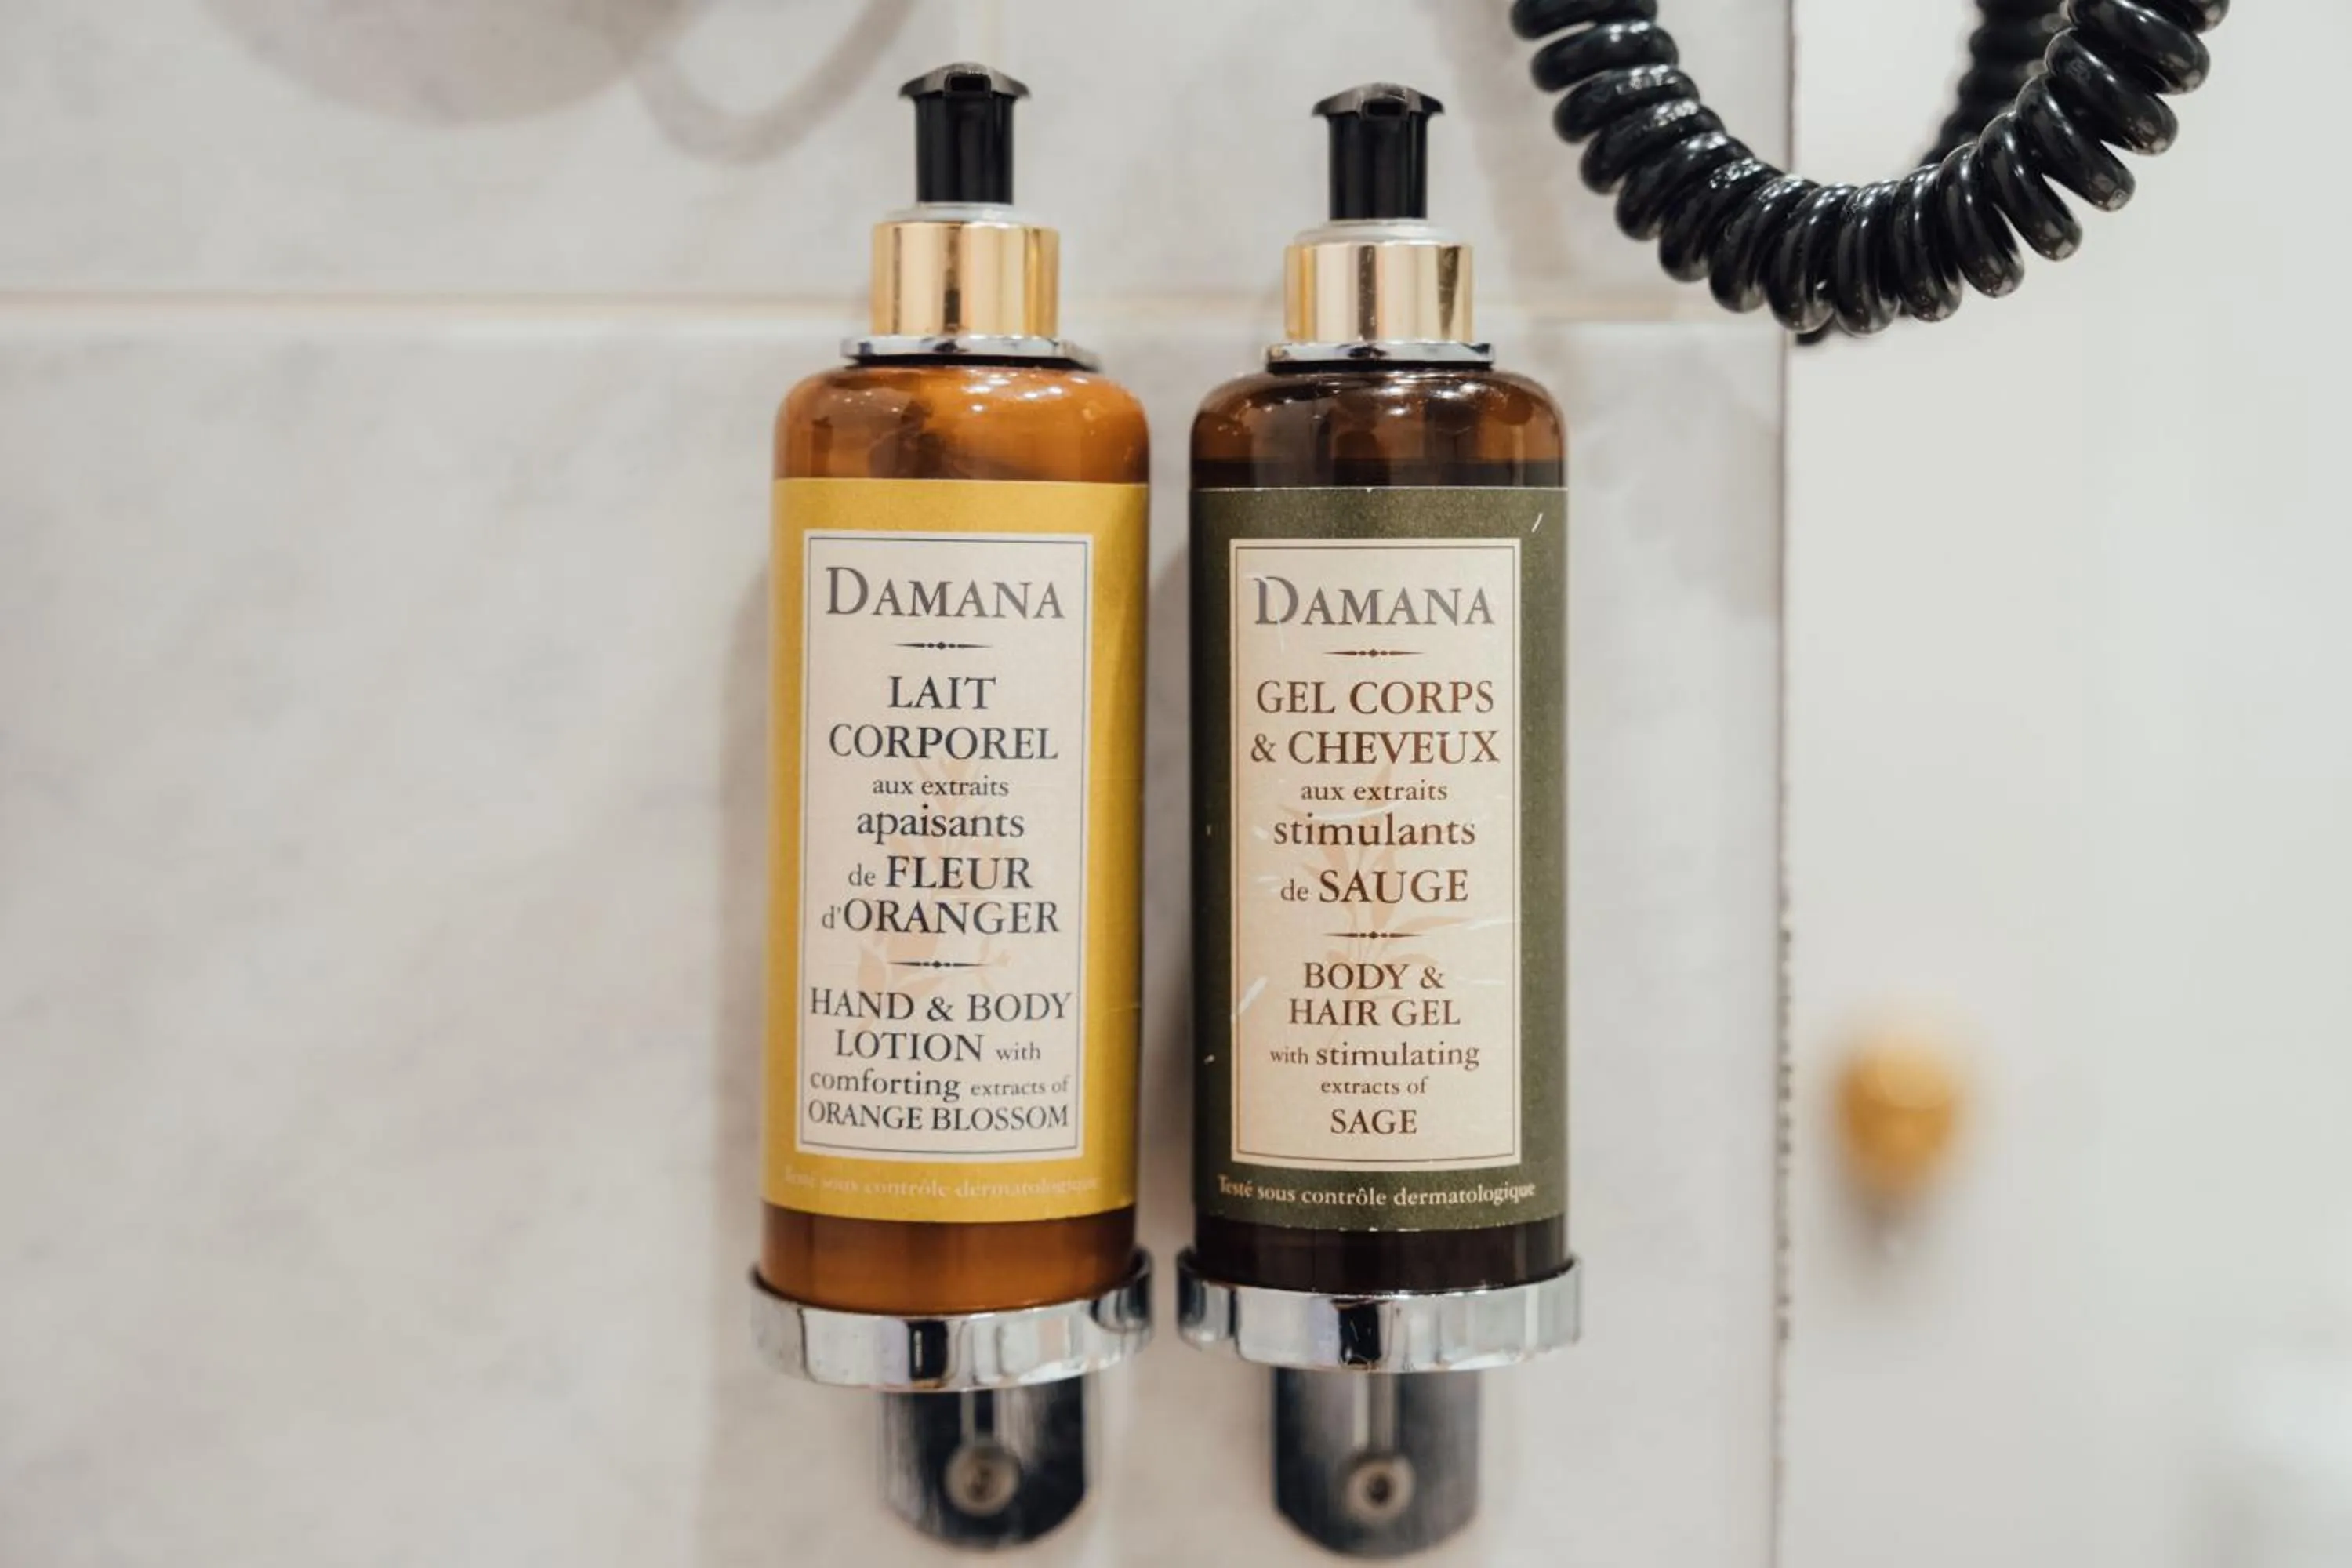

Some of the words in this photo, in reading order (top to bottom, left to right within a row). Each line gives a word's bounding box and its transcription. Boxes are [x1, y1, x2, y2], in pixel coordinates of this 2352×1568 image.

[826, 566, 1065, 619] DAMANA
[1254, 576, 1494, 626] DAMANA
[889, 676, 996, 710] LAIT
[1256, 680, 1335, 713] GEL
[1349, 680, 1494, 714] CORPS
[829, 723, 1058, 760] CORPOREL
[1250, 734, 1276, 762] &
[1288, 730, 1500, 764] CHEVEUX
[873, 778, 914, 795] aux
[921, 775, 1009, 797] extraits
[1301, 786, 1345, 800] aux
[1353, 779, 1448, 800] extraits
[856, 804, 1025, 844] apaisants
[1273, 811, 1476, 846] stimulants
[848, 864, 876, 887] de
[886, 855, 1033, 889] FLEUR
[1280, 879, 1308, 901] de
[1319, 869, 1468, 903] SAUGE
[822, 898, 1061, 935] d'ORANGER
[1304, 962, 1411, 990] BODY
[1420, 965, 1445, 989] &
[811, 986, 914, 1019] HAND
[927, 996, 953, 1021] &
[967, 991, 1073, 1019] BODY
[1289, 998, 1380, 1026] HAIR
[1392, 1000, 1461, 1026] GEL
[835, 1029, 985, 1062] LOTION
[996, 1043, 1041, 1060] with
[1270, 1047, 1308, 1065] with
[1316, 1041, 1480, 1071] stimulating
[810, 1069, 961, 1102] comforting
[970, 1080, 1046, 1095] extracts
[1051, 1075, 1072, 1093] of
[1320, 1080, 1400, 1094] extracts
[1407, 1076, 1428, 1094] of
[808, 1099, 923, 1131] ORANGE
[931, 1103, 1069, 1131] BLOSSOM
[1330, 1108, 1417, 1134] SAGE
[1257, 1185, 1296, 1202] sous
[1301, 1188, 1387, 1207] contrôle
[1393, 1181, 1536, 1207] dermatologique
